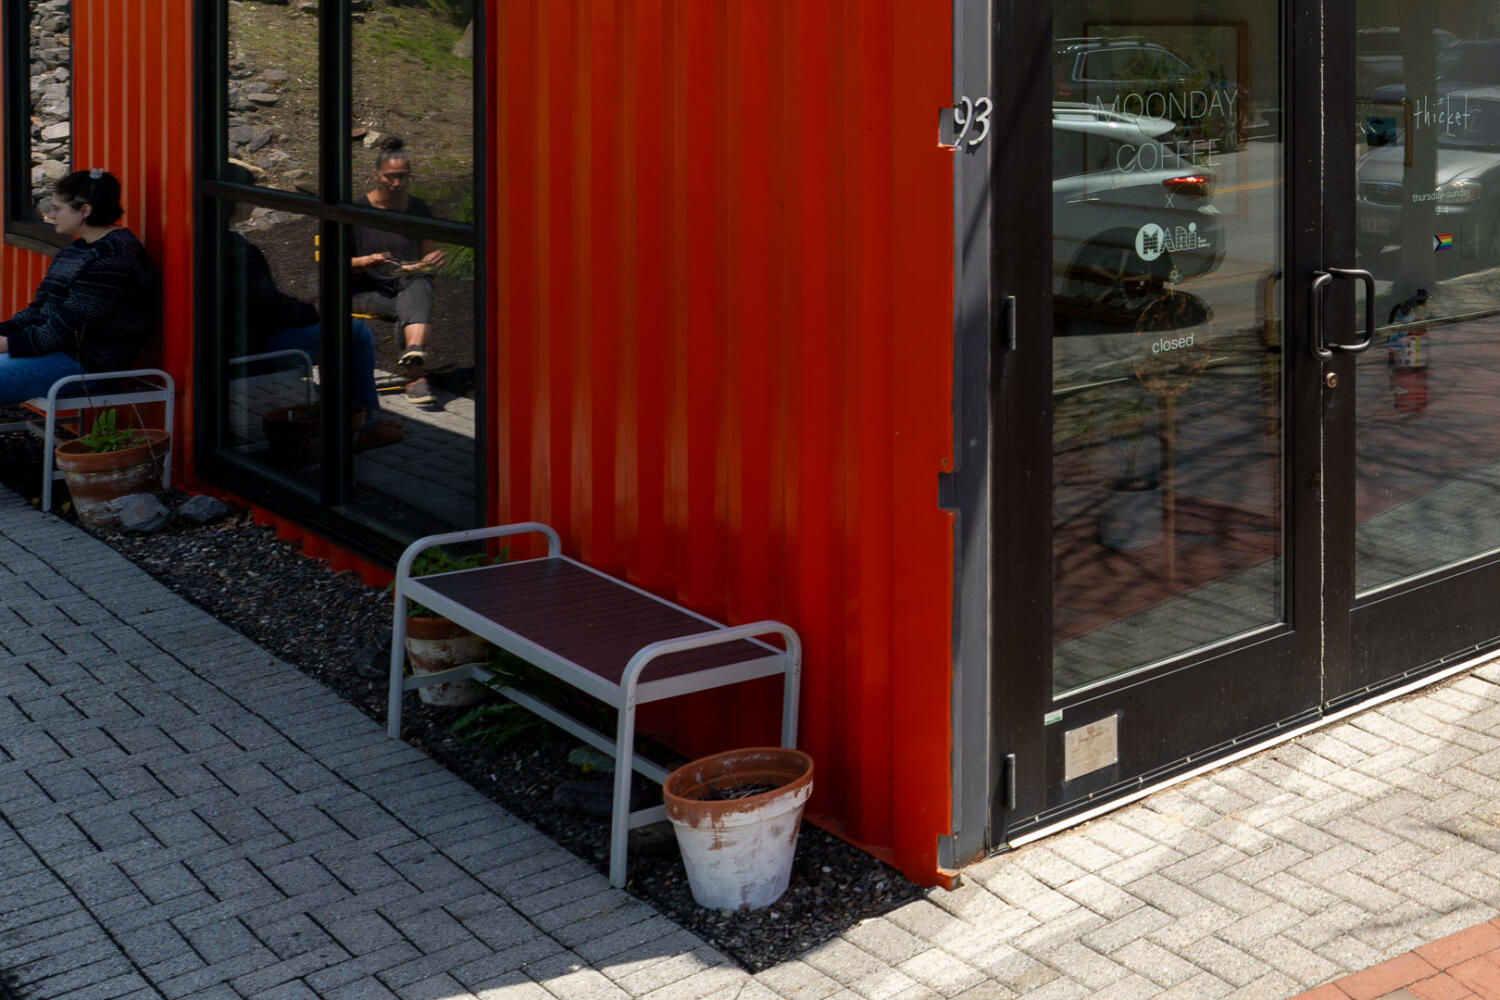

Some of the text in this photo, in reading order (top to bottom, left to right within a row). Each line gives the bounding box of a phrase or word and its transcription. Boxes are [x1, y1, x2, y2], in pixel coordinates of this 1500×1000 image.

[953, 95, 993, 151] 93
[1096, 88, 1239, 122] MOONDAY
[1412, 93, 1471, 131] thicket
[1116, 138, 1222, 174] COFFEE
[1151, 332, 1195, 354] closed
